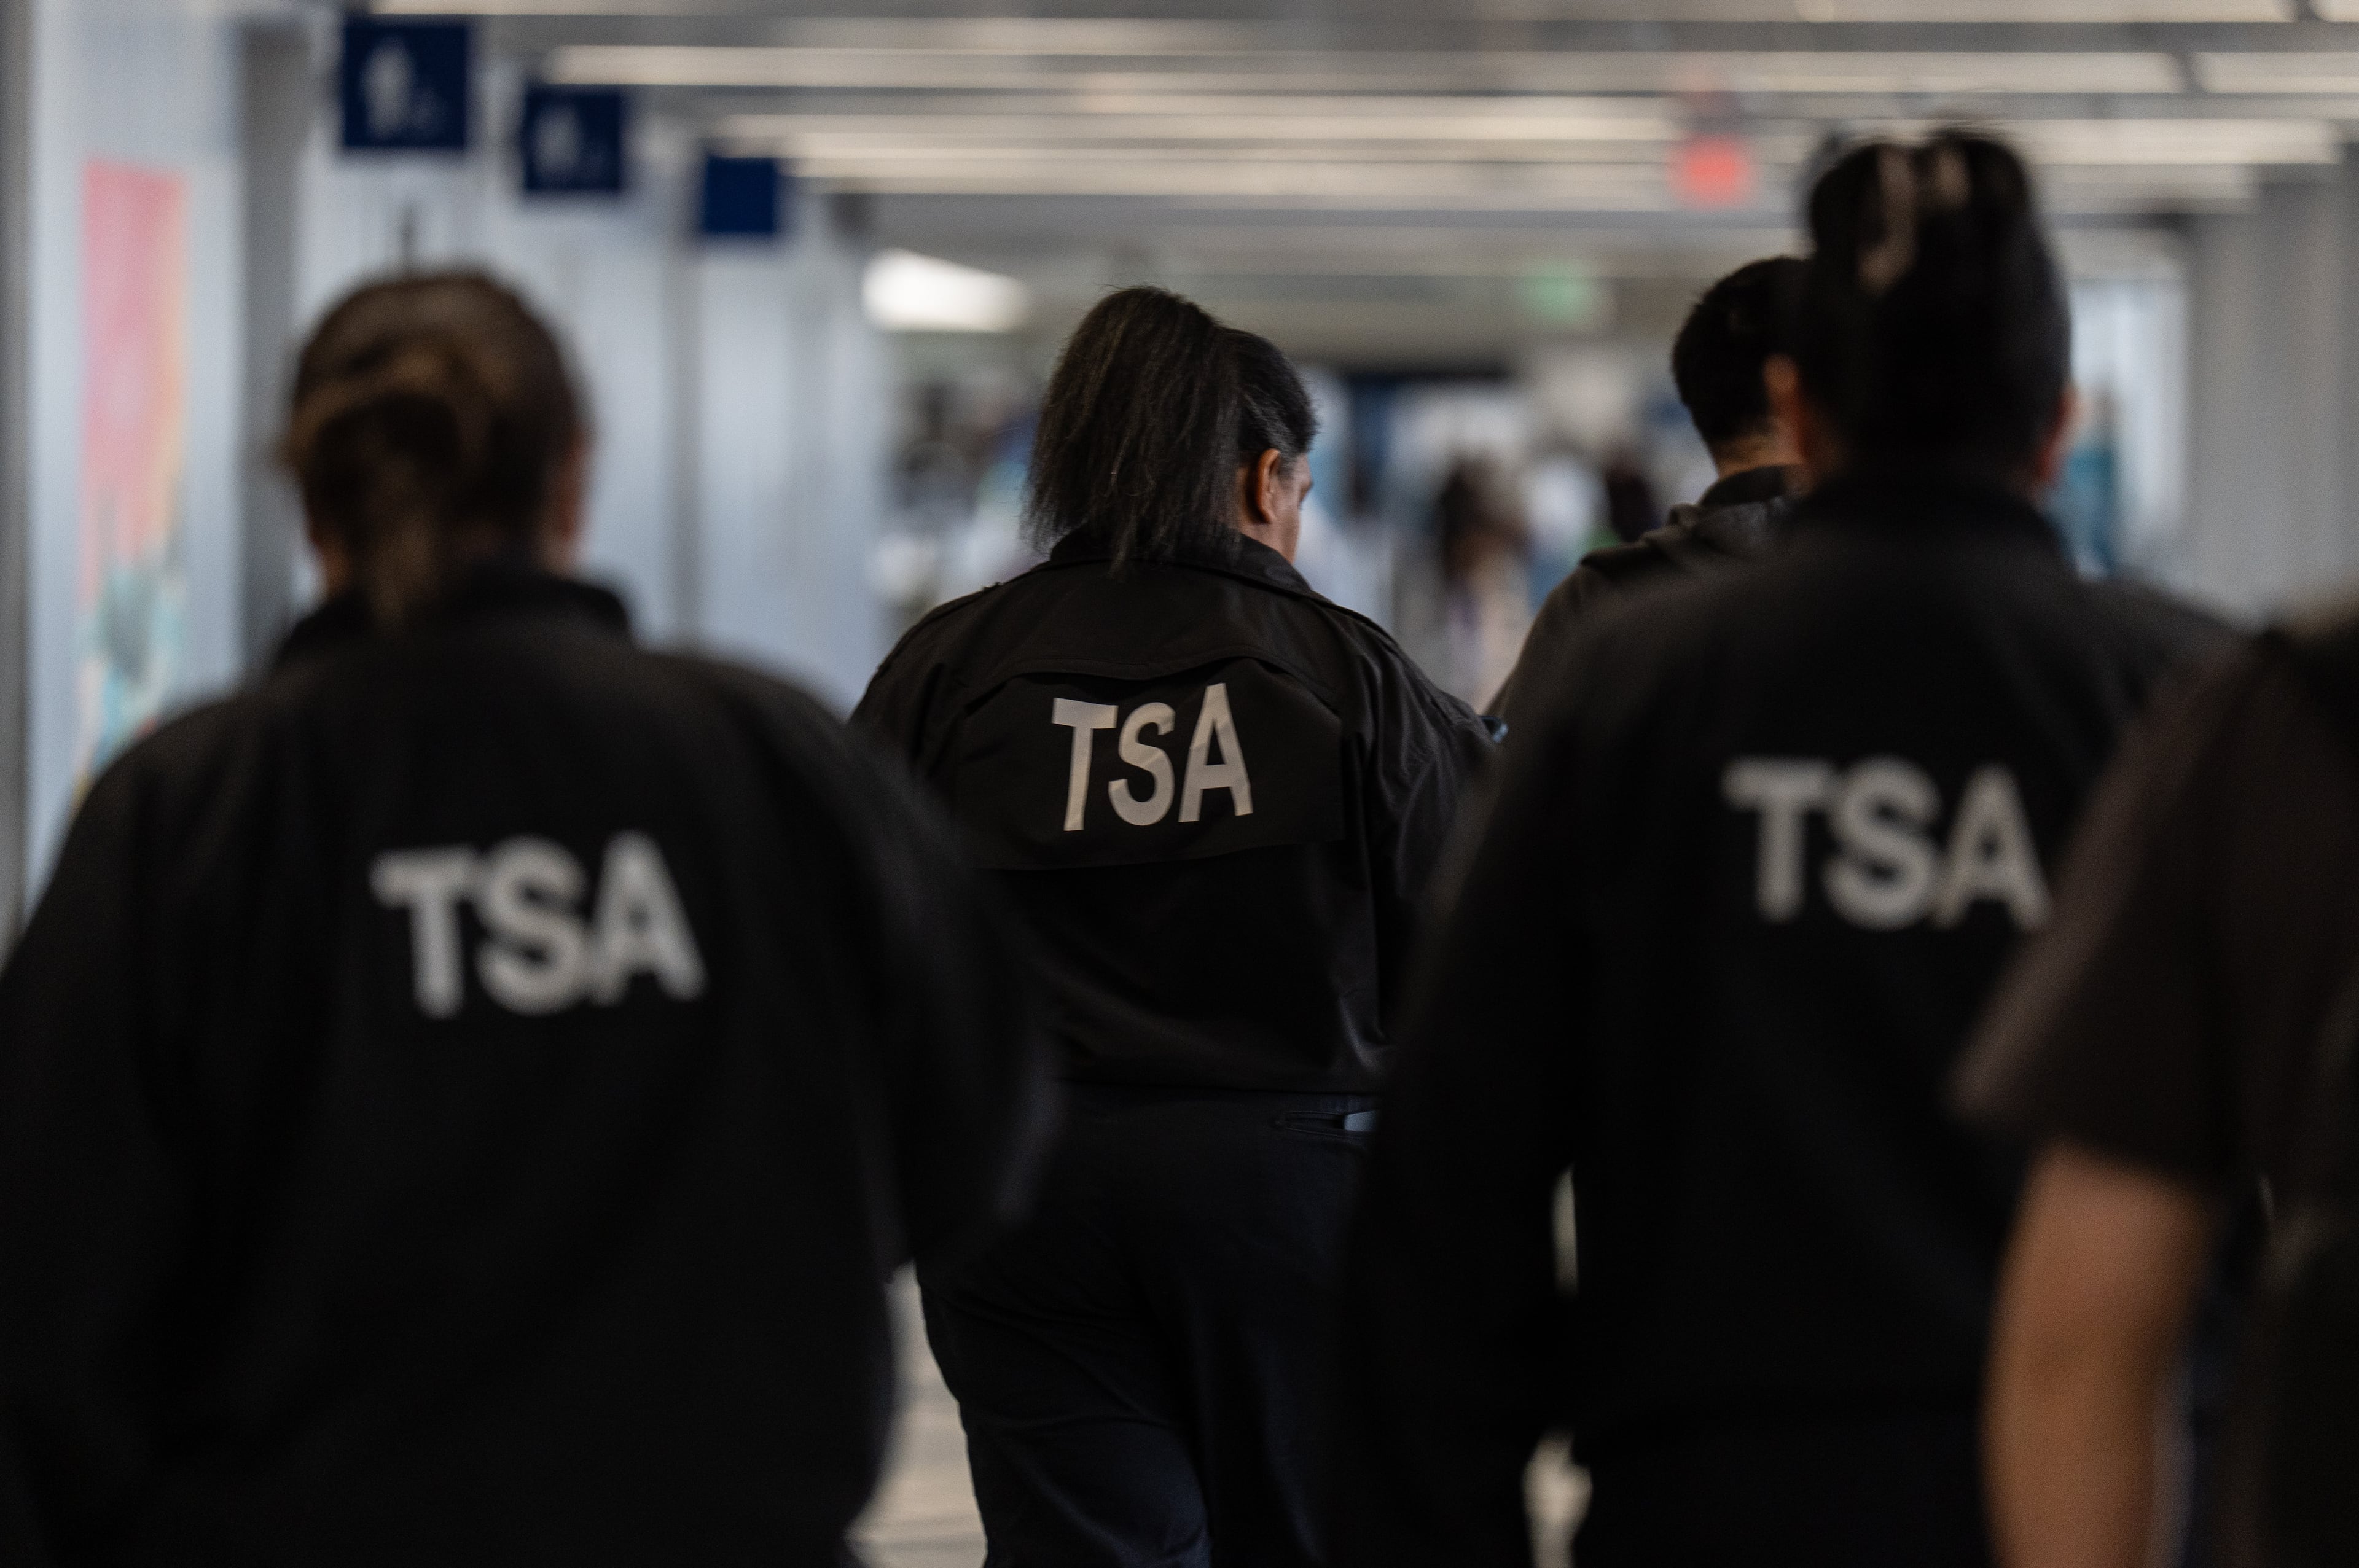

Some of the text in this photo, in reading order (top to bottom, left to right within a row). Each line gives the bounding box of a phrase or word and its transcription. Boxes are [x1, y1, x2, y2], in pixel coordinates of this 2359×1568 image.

[1052, 683, 1253, 832] TSA
[371, 832, 706, 1019] TSA
[1725, 758, 2051, 929] TSA
